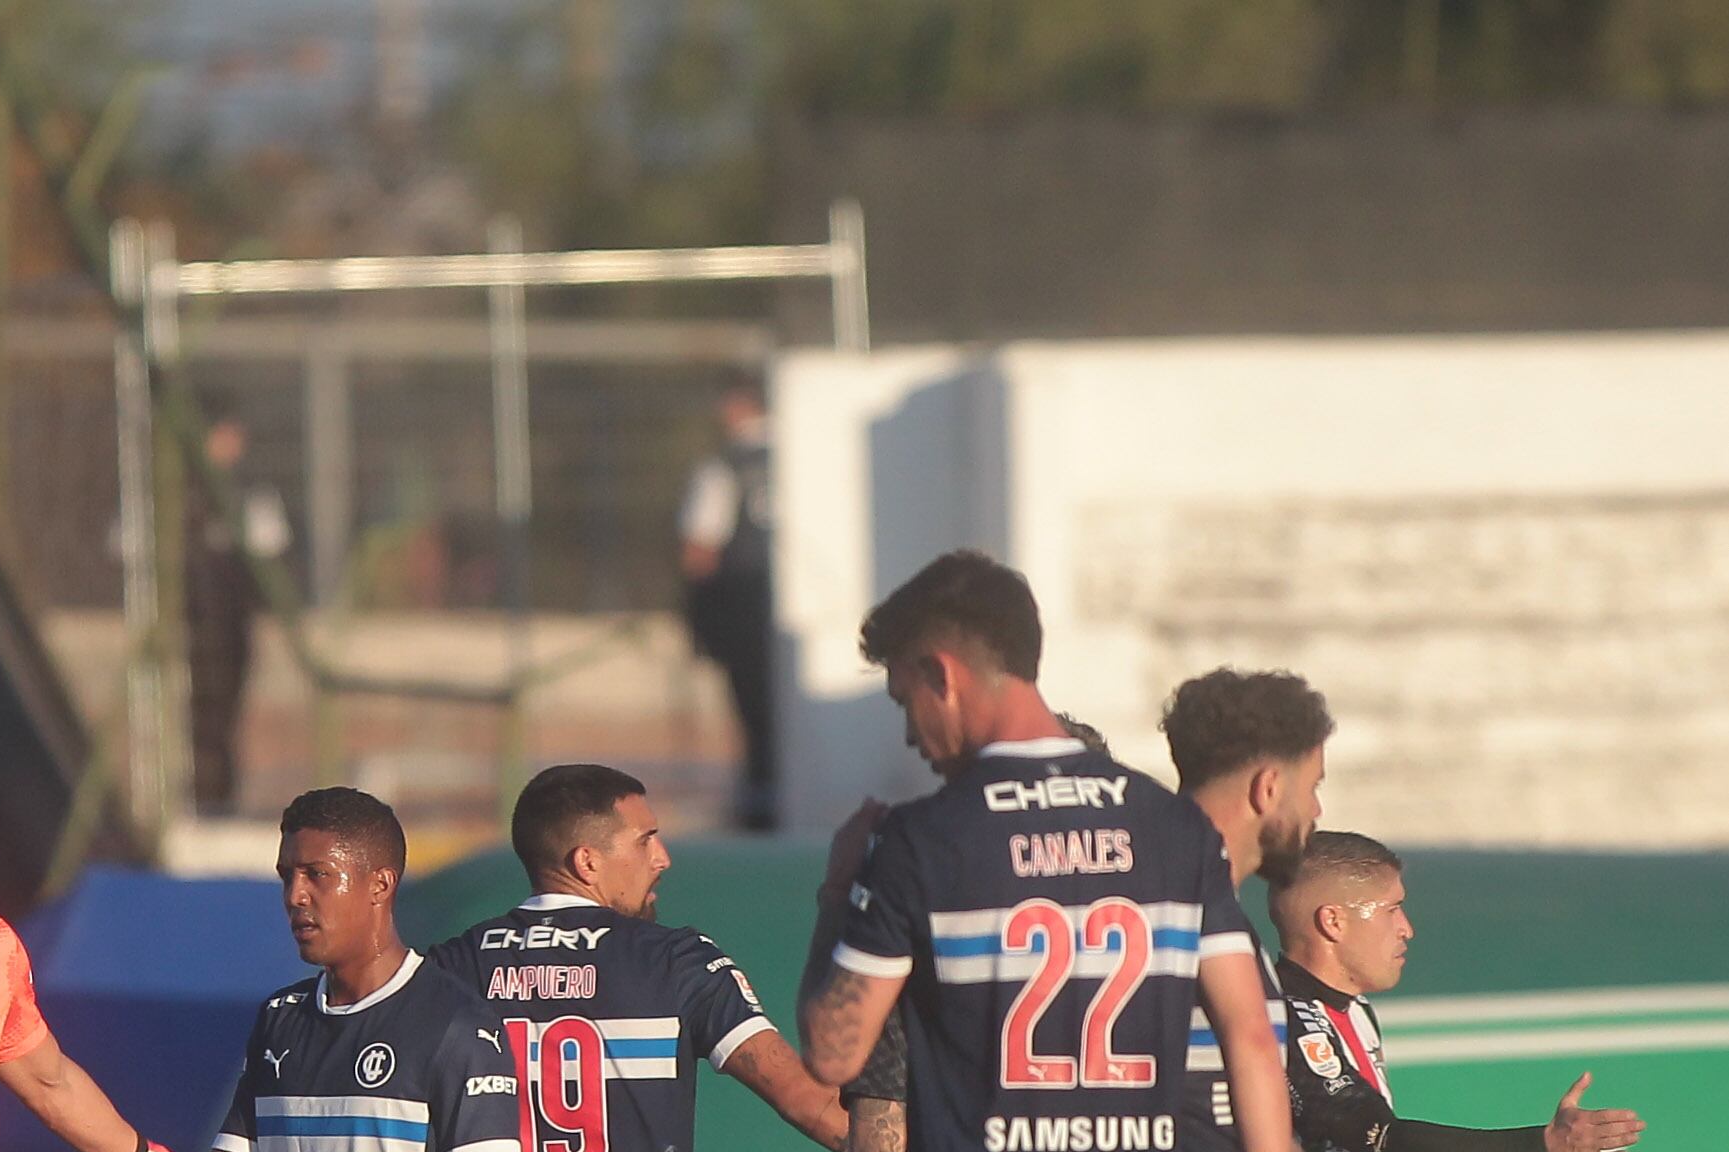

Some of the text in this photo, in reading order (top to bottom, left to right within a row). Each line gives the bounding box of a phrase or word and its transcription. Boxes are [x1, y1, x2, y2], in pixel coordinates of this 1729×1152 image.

[984, 776, 1128, 812] CHERY
[1009, 829, 1134, 878] CANALES
[480, 927, 610, 950] CHERY
[487, 964, 597, 999] AMPUERO
[1000, 896, 1157, 1090] 22
